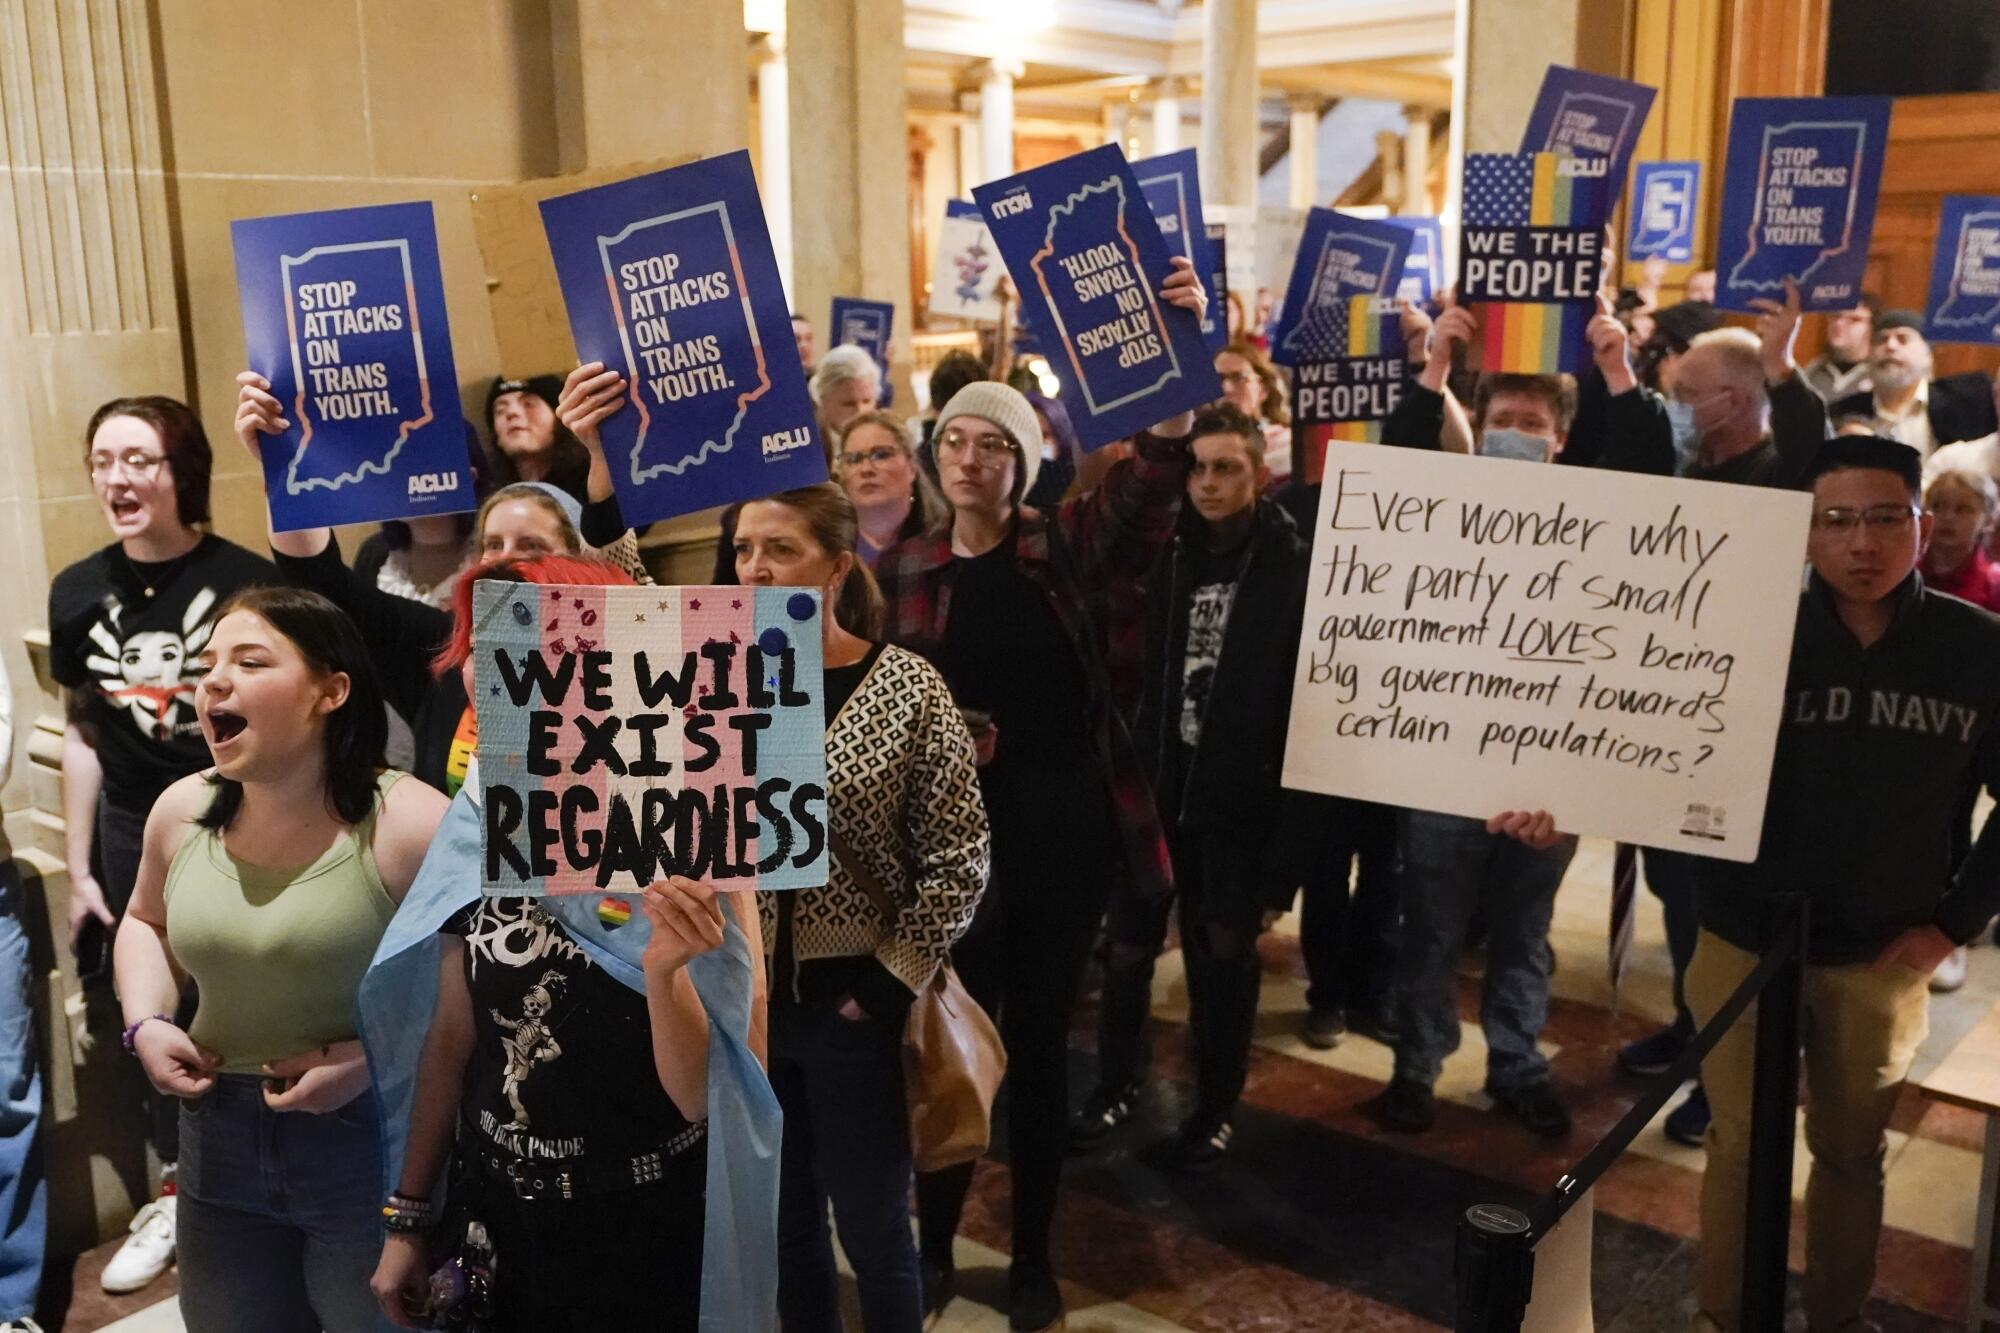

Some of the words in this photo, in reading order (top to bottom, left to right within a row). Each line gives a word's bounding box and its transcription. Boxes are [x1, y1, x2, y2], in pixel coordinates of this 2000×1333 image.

[1555, 158, 1607, 177] ACLU
[1772, 147, 1819, 166] STOP
[1769, 166, 1848, 187] ATTACKS
[991, 191, 1033, 220] ACLU
[1767, 187, 1793, 206] ON
[1766, 207, 1824, 226] TRANS
[1467, 232, 1516, 254] WE
[1530, 232, 1597, 255] THE
[1764, 226, 1824, 246] YOUTH.
[620, 253, 680, 291] STOP
[1059, 241, 1125, 279] YOUTH.
[1074, 264, 1135, 302] TRANS
[1465, 258, 1593, 298] PEOPLE
[298, 280, 357, 311] STOP
[630, 271, 730, 320] ATTACKS
[1115, 287, 1144, 315] ON
[304, 304, 402, 338] ATTACKS
[634, 316, 671, 348] ON
[1077, 310, 1151, 357] ATTACKS
[306, 339, 341, 367] ON
[640, 335, 721, 376] TRANS
[1118, 333, 1161, 368] STOP
[309, 362, 388, 394] TRANS
[648, 363, 735, 404] YOUTH.
[1299, 362, 1339, 383] WE
[1349, 359, 1403, 381] THE
[314, 391, 399, 421] YOUTH.
[762, 426, 811, 456] ACLU
[408, 471, 458, 495] ACLU
[1331, 468, 1448, 533] Ever
[1460, 502, 1609, 552] wonder
[1630, 504, 1729, 594] why
[1322, 544, 1392, 597] the
[1404, 557, 1509, 616] party
[1526, 560, 1573, 602] of
[1581, 574, 1711, 629] small
[1319, 613, 1490, 664] government
[1499, 612, 1619, 661] LOVES
[1640, 633, 1734, 698] being
[494, 648, 613, 711] WE
[633, 641, 811, 711] WILL
[1308, 651, 1358, 704] big
[1378, 665, 1561, 709] government
[1579, 674, 1726, 733] towards
[1868, 689, 1978, 743] NAVY
[526, 710, 772, 776] EXIST
[1336, 706, 1450, 743] certain
[1479, 721, 1714, 778] populations?
[485, 777, 825, 889] REGARDLESS
[528, 1136, 584, 1159] PARADE
